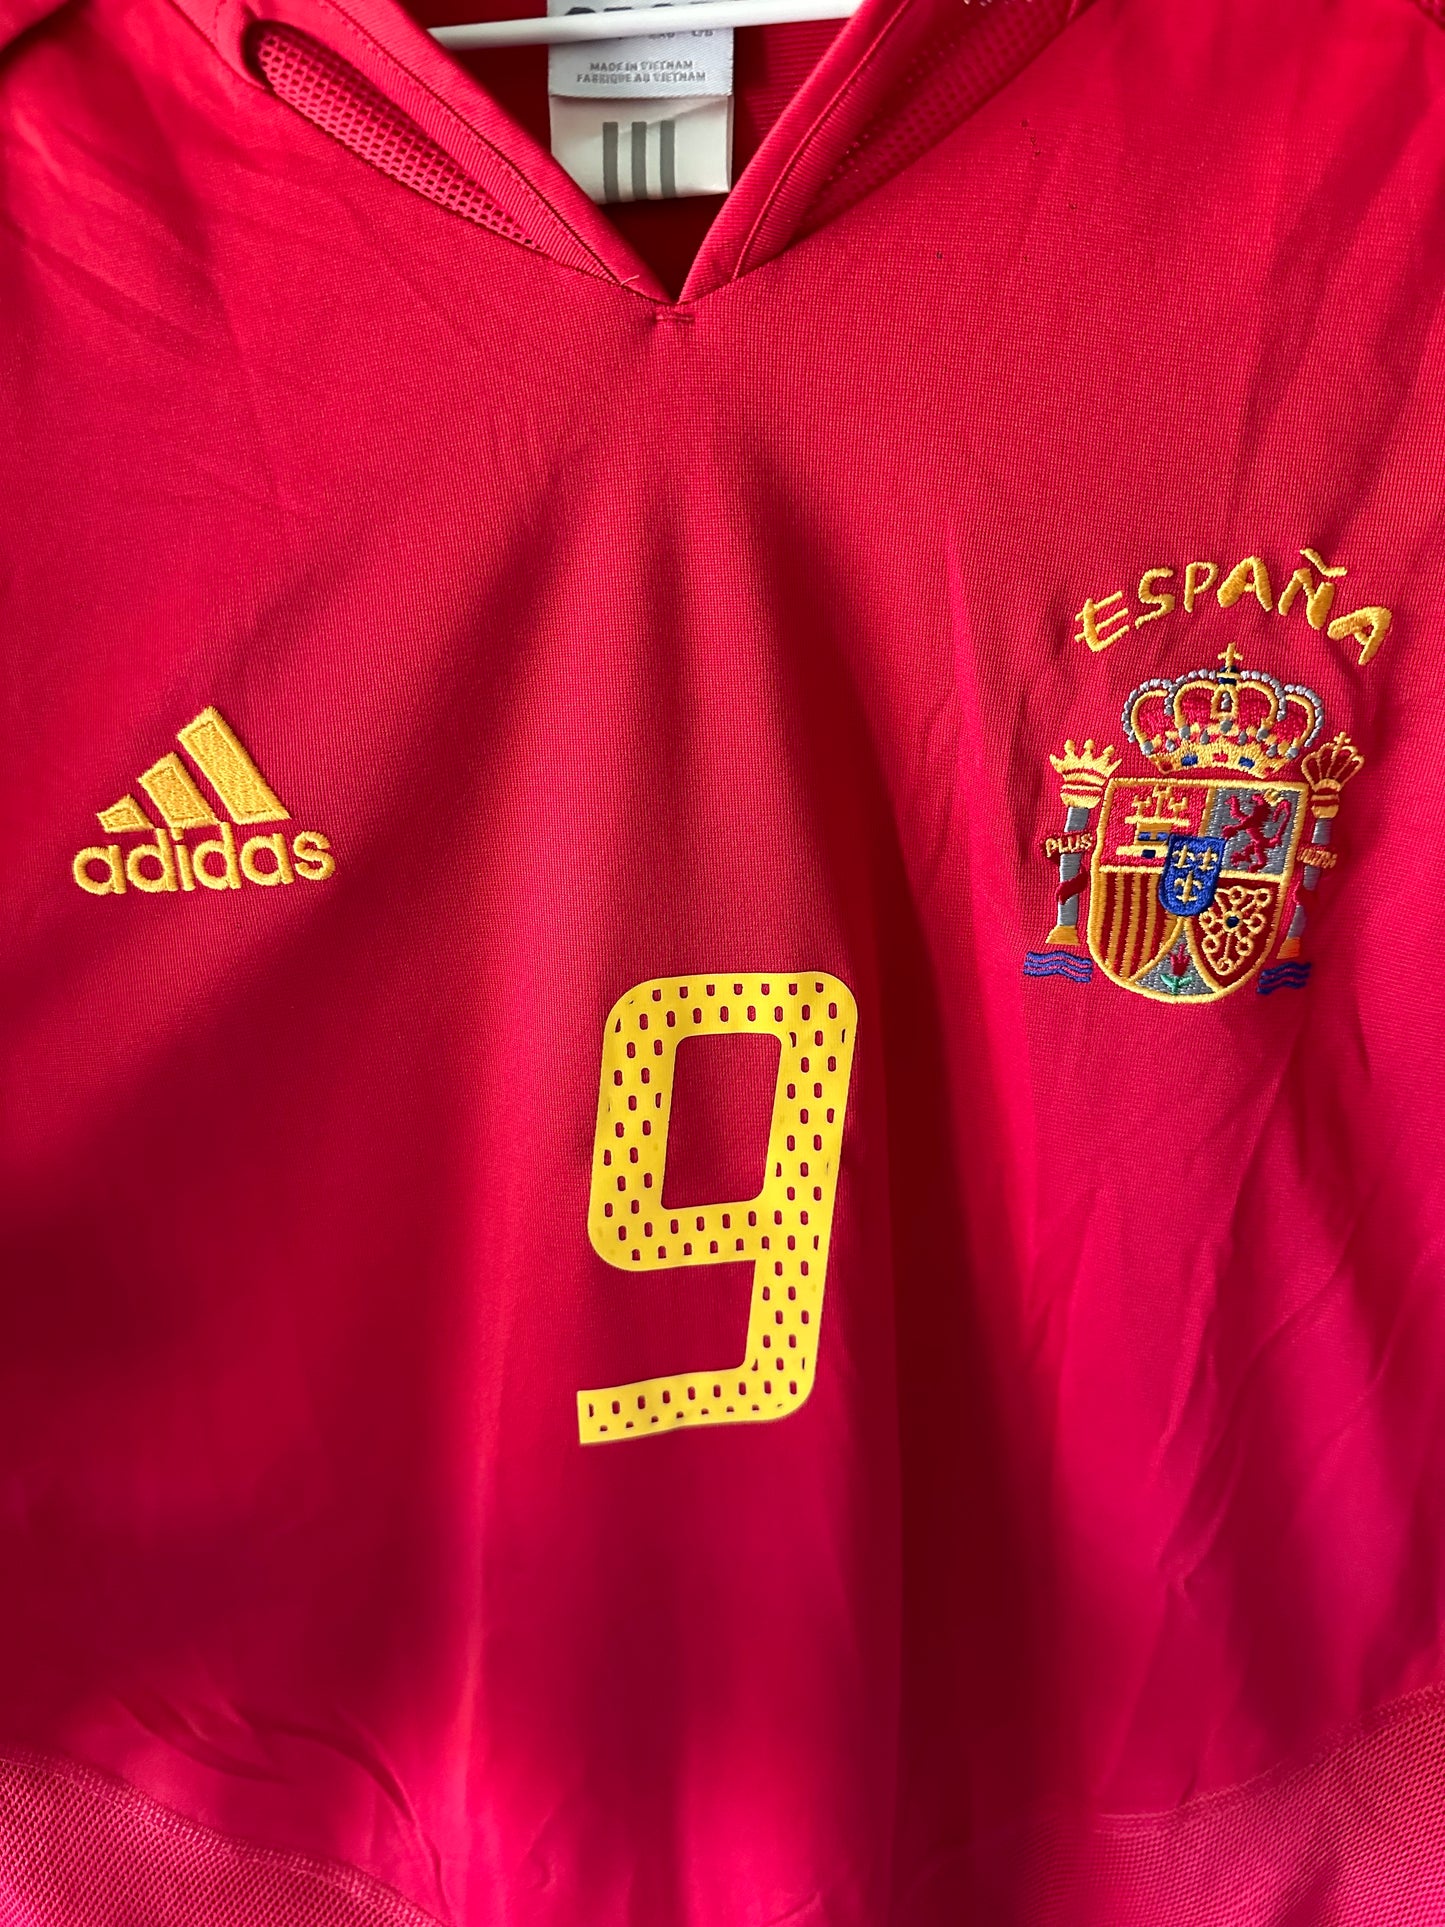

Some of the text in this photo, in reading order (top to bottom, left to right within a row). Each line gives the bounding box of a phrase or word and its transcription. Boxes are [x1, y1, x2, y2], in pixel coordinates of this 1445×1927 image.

[590, 60, 693, 72] MADE IN VIETNAM
[634, 73, 650, 82] AU
[653, 71, 706, 82] VIETNAM
[1075, 547, 1392, 666] ESPAÑA
[73, 821, 336, 895] adidas
[1045, 833, 1093, 858] PLUS
[577, 971, 858, 1446] 9
